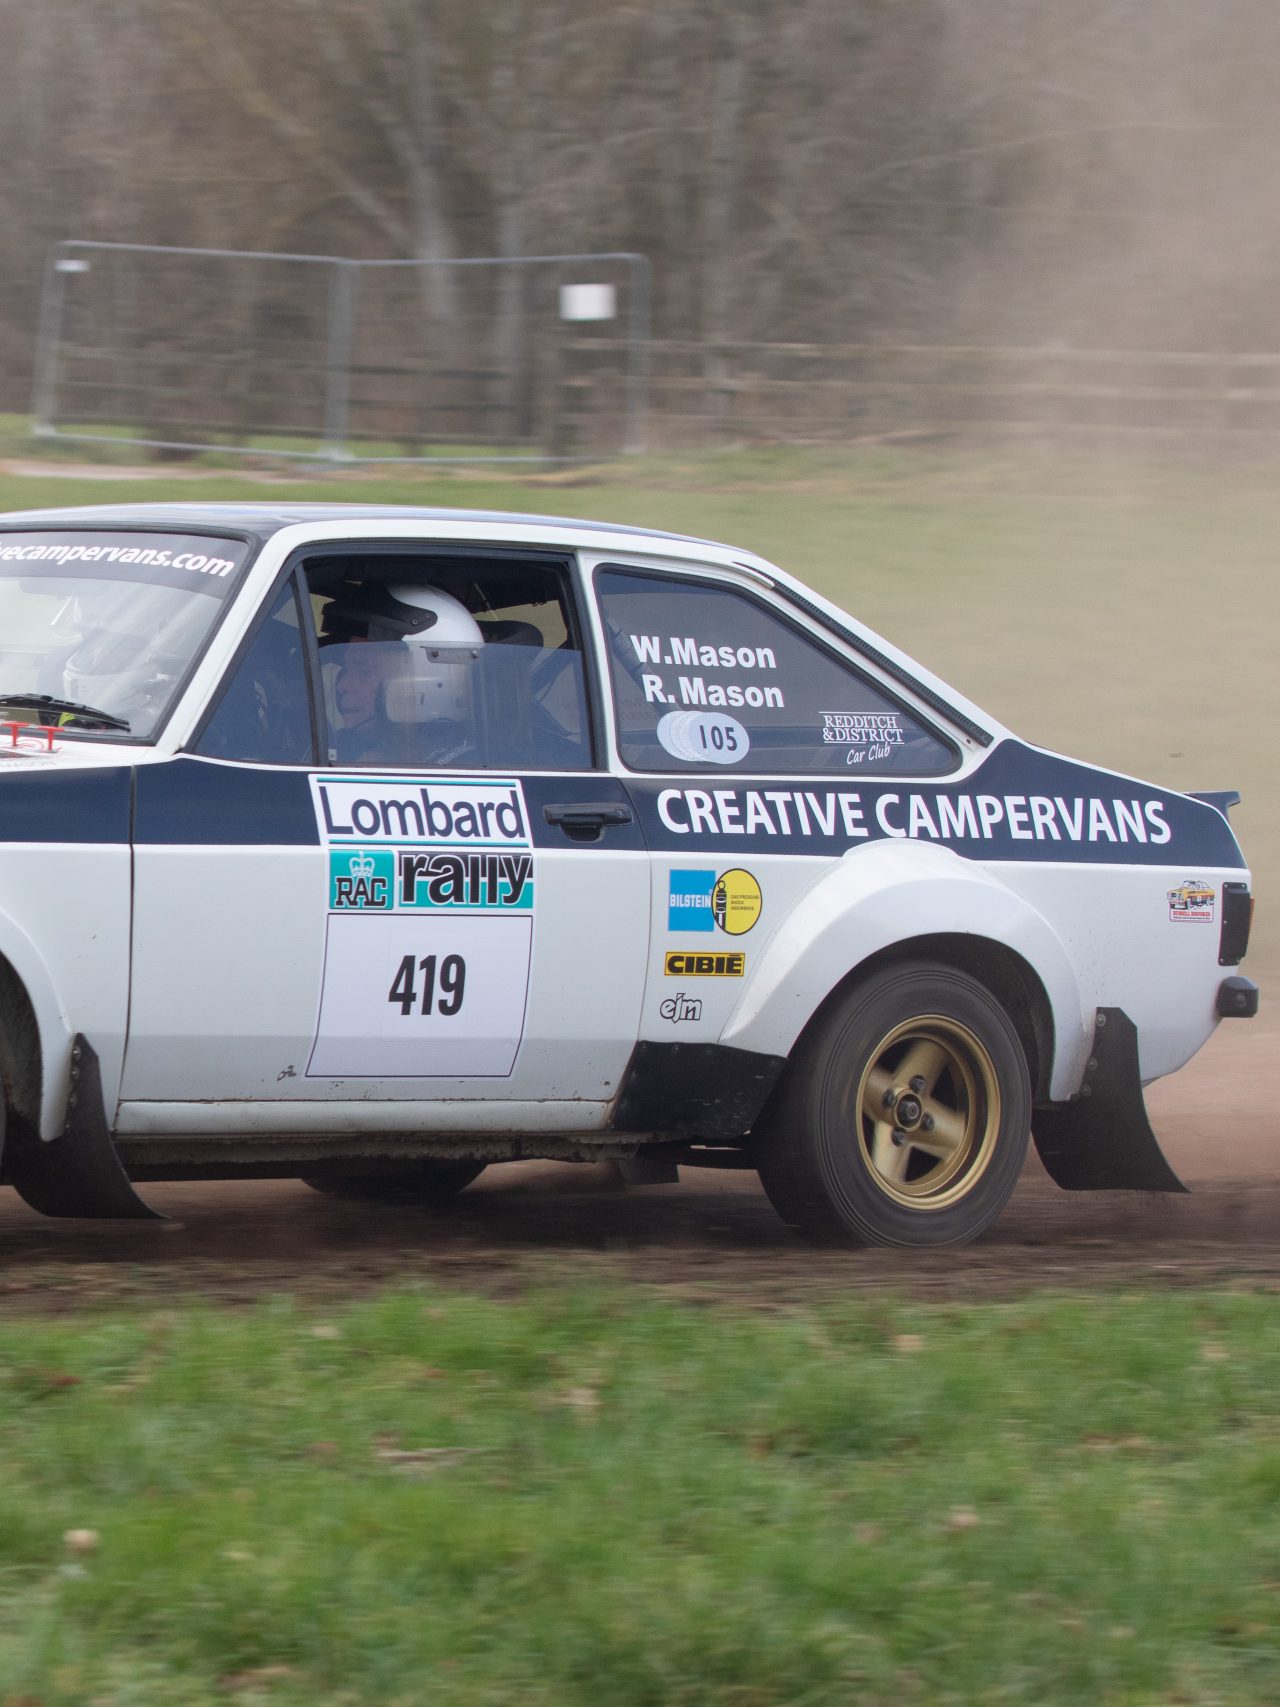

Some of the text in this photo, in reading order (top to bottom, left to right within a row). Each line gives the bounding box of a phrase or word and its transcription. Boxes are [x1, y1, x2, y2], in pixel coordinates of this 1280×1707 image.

[629, 634, 777, 669] W.Mason
[642, 673, 785, 708] R. Mason
[700, 725, 738, 751] 105
[823, 715, 898, 729] REDDITCH
[846, 741, 891, 765] Car Club
[318, 785, 526, 839] Lombard
[657, 788, 1172, 845] CREATIVE CAMPERVANS
[334, 876, 389, 908] RAC
[400, 853, 533, 905] rally
[669, 893, 713, 908] BILSTEIN
[387, 953, 467, 1016] 419
